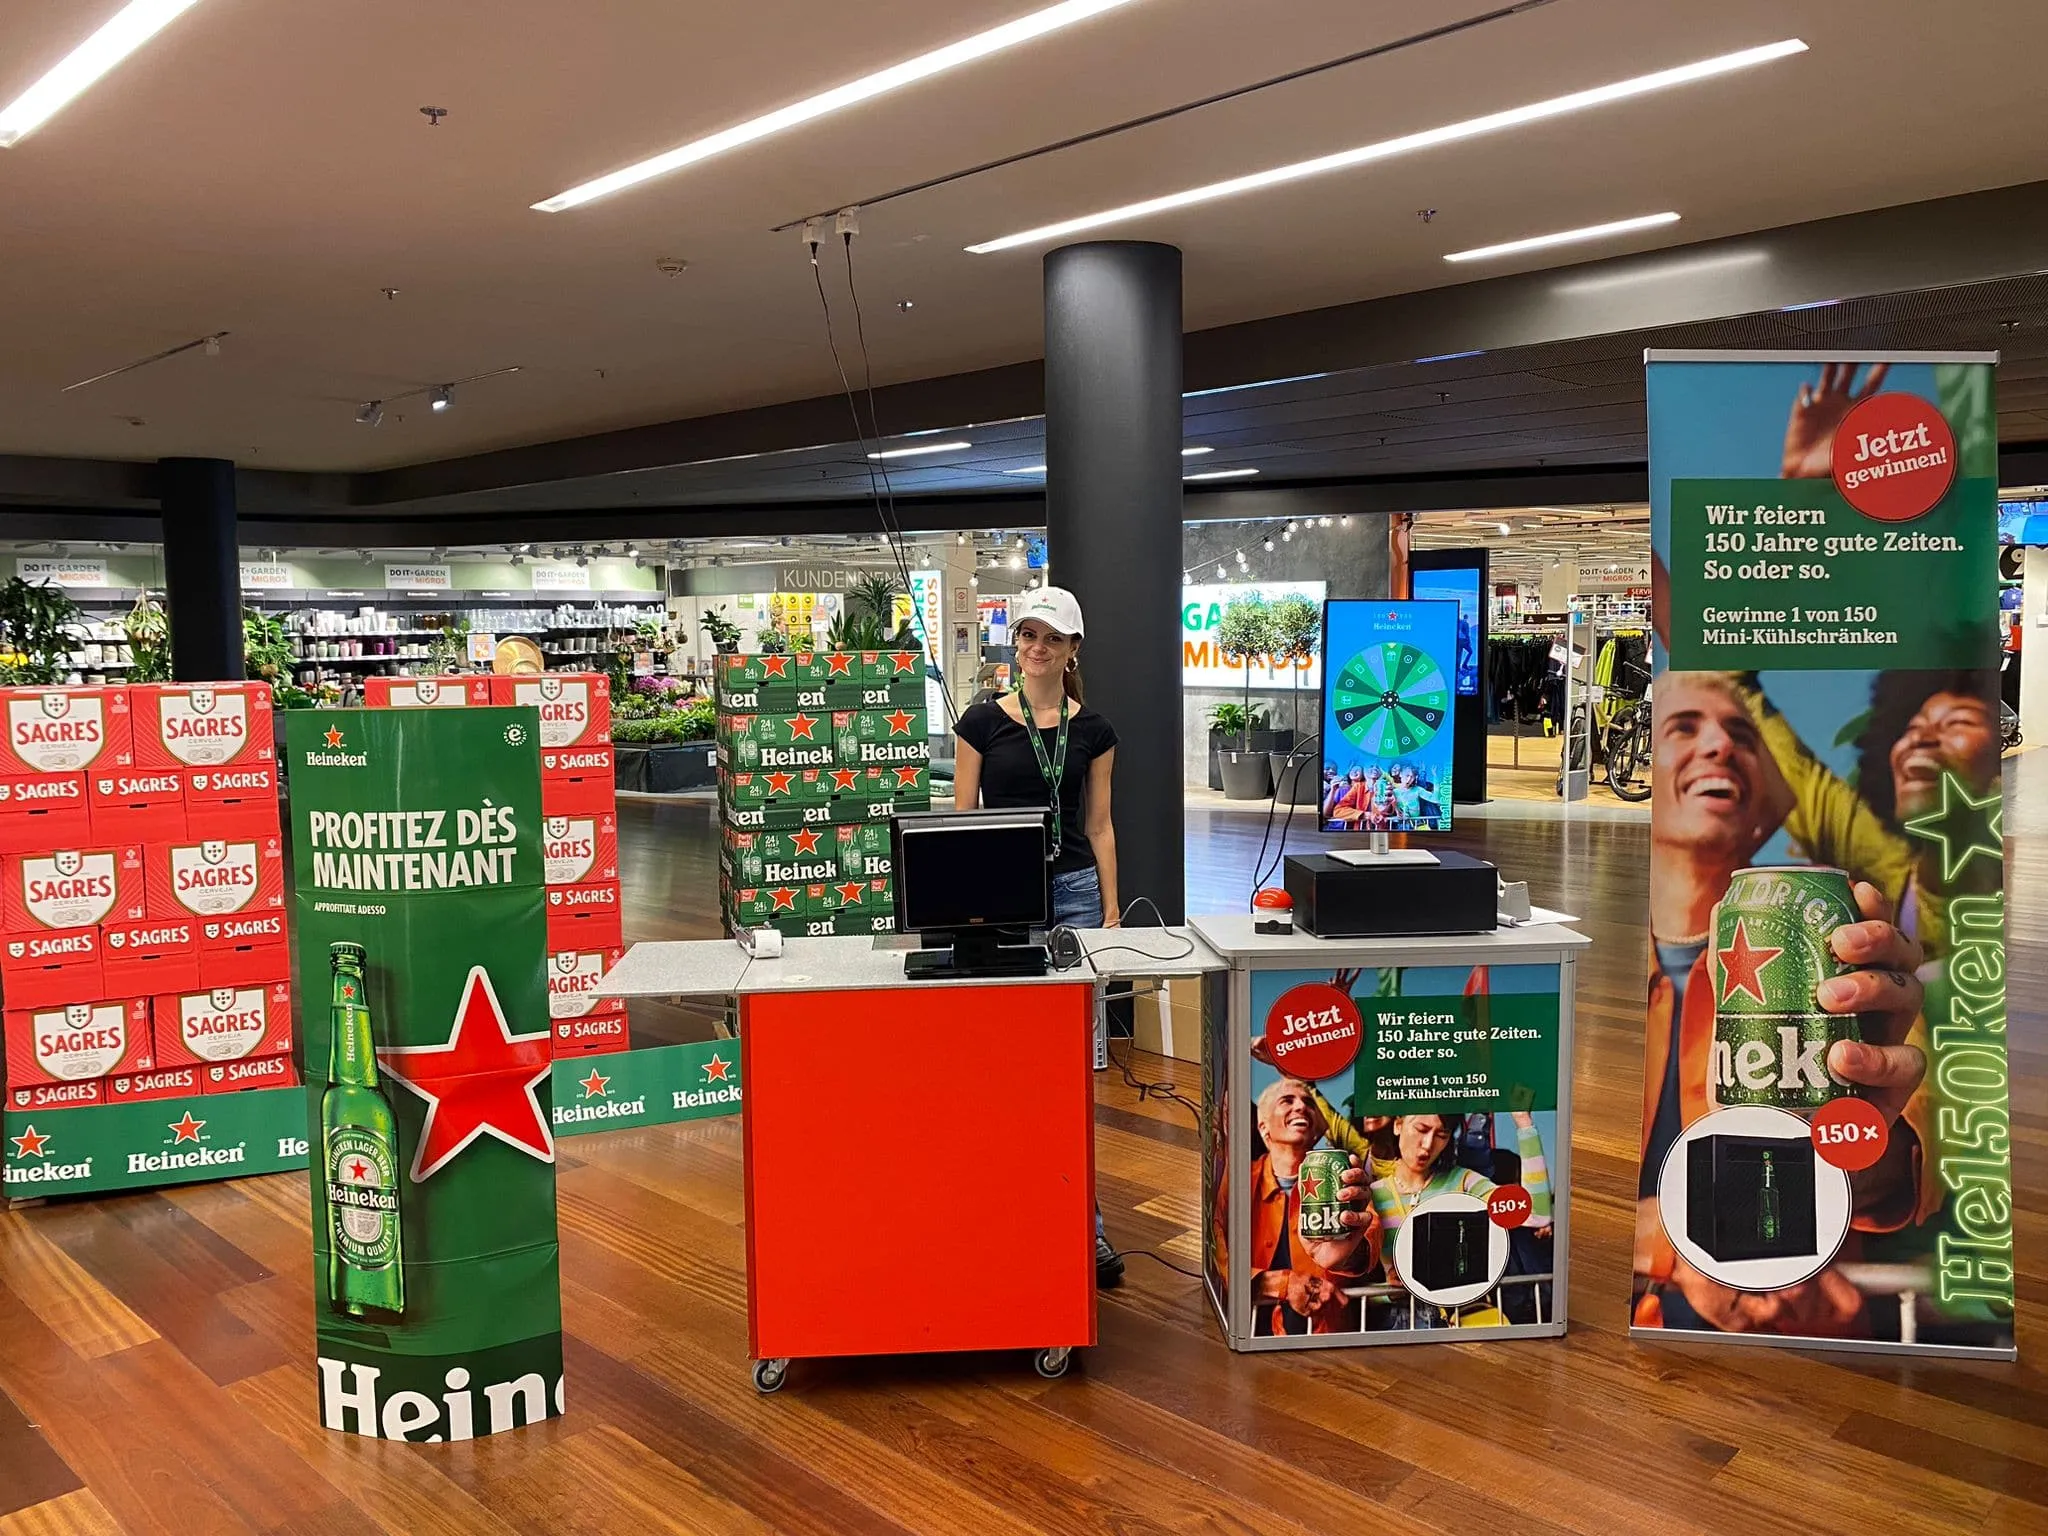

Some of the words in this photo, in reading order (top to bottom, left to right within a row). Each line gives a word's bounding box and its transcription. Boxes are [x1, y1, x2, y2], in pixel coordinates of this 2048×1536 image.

[1854, 422, 1933, 463] Jetzt
[1845, 446, 1948, 490] gewinnen!
[1705, 505, 1749, 526] Wir
[1753, 504, 1826, 526] feiern
[1705, 533, 1746, 552] 150
[1751, 532, 1819, 553] Jahre
[1824, 534, 1878, 557] gute
[1883, 531, 1964, 552] Zeiten.
[24, 564, 40, 572] DO
[58, 565, 101, 573] GARDEN
[58, 573, 101, 581] MIGROS
[250, 567, 287, 575] GARDEN
[251, 575, 287, 583] MIGROS
[389, 569, 401, 577] DO
[414, 569, 446, 577] GARDEN
[1703, 560, 1733, 580] So
[1737, 559, 1793, 580] oder
[1798, 563, 1831, 580] so.
[415, 577, 446, 585] MIGROS
[1702, 606, 1787, 624] Gewinne
[1791, 607, 1801, 623] 1
[1805, 610, 1840, 623] von
[1844, 606, 1877, 623] 150
[1702, 627, 1898, 645] Mini-Kühlschränken
[798, 686, 826, 707] en
[863, 684, 891, 704] en
[540, 702, 585, 722] GRES
[16, 719, 100, 746] SAGRES
[166, 715, 244, 740] SAGRES
[306, 750, 368, 767] Heineken
[560, 752, 609, 770] SAGRES
[15, 780, 80, 801] SAGRES
[118, 775, 180, 796] SAGRES
[212, 771, 270, 790] SAGRES
[803, 801, 831, 822] en
[868, 797, 895, 817] en
[309, 810, 447, 849] PROFITEZ
[456, 798, 518, 846] DÈS
[543, 838, 592, 860] AGRES
[177, 864, 254, 891] SAGRES
[313, 847, 518, 890] MAINTENANT
[30, 875, 112, 903] SAGRES
[565, 888, 615, 905] SAGRES
[314, 902, 357, 914] APPROFITTATE
[357, 904, 386, 915] ADESSO
[129, 925, 190, 948] SAGRES
[223, 917, 281, 938] SAGRES
[807, 916, 836, 936] en
[29, 934, 93, 958] SAGRES
[549, 972, 599, 994] AGRES
[186, 1009, 262, 1038] SAGRES
[574, 1019, 622, 1038] SAGRES
[1282, 1004, 1343, 1036] Jetzt
[1377, 1013, 1405, 1026] Wir
[1408, 1012, 1455, 1026] feiern
[40, 1027, 121, 1057] SAGRES
[345, 1003, 355, 1062] Heineken
[1275, 1024, 1356, 1057] gewinnen!
[1377, 1030, 1403, 1043] 150
[1407, 1029, 1450, 1042] Jahre
[1453, 1029, 1487, 1045] gute
[1490, 1026, 1542, 1040] Zeiten.
[1377, 1046, 1395, 1060] So
[1398, 1046, 1434, 1059] oder
[1437, 1048, 1458, 1059] so.
[1715, 1026, 1851, 1090] nek
[228, 1058, 285, 1081] SAGRES
[134, 1069, 194, 1092] SAGRES
[1377, 1075, 1430, 1087] Gewinne
[1433, 1075, 1439, 1085] 1
[1442, 1076, 1463, 1085] von
[1466, 1074, 1487, 1084] 150
[35, 1082, 97, 1105] SAGRES
[1376, 1086, 1500, 1101] Mini-Kühlschränken
[552, 1095, 646, 1125] Heineken
[1817, 1121, 1861, 1145] 150
[127, 1141, 246, 1174] Heineken
[278, 1137, 309, 1158] He
[330, 1140, 353, 1171] HEINEKEN
[353, 1140, 378, 1159] LAGER
[376, 1153, 390, 1178] BEER
[3, 1157, 93, 1183] ineken
[328, 1183, 397, 1210] Heineken
[1490, 1200, 1516, 1214] 150
[1300, 1207, 1346, 1231] nek
[334, 1221, 365, 1257] PREMIUM
[366, 1229, 393, 1257] QUALITY
